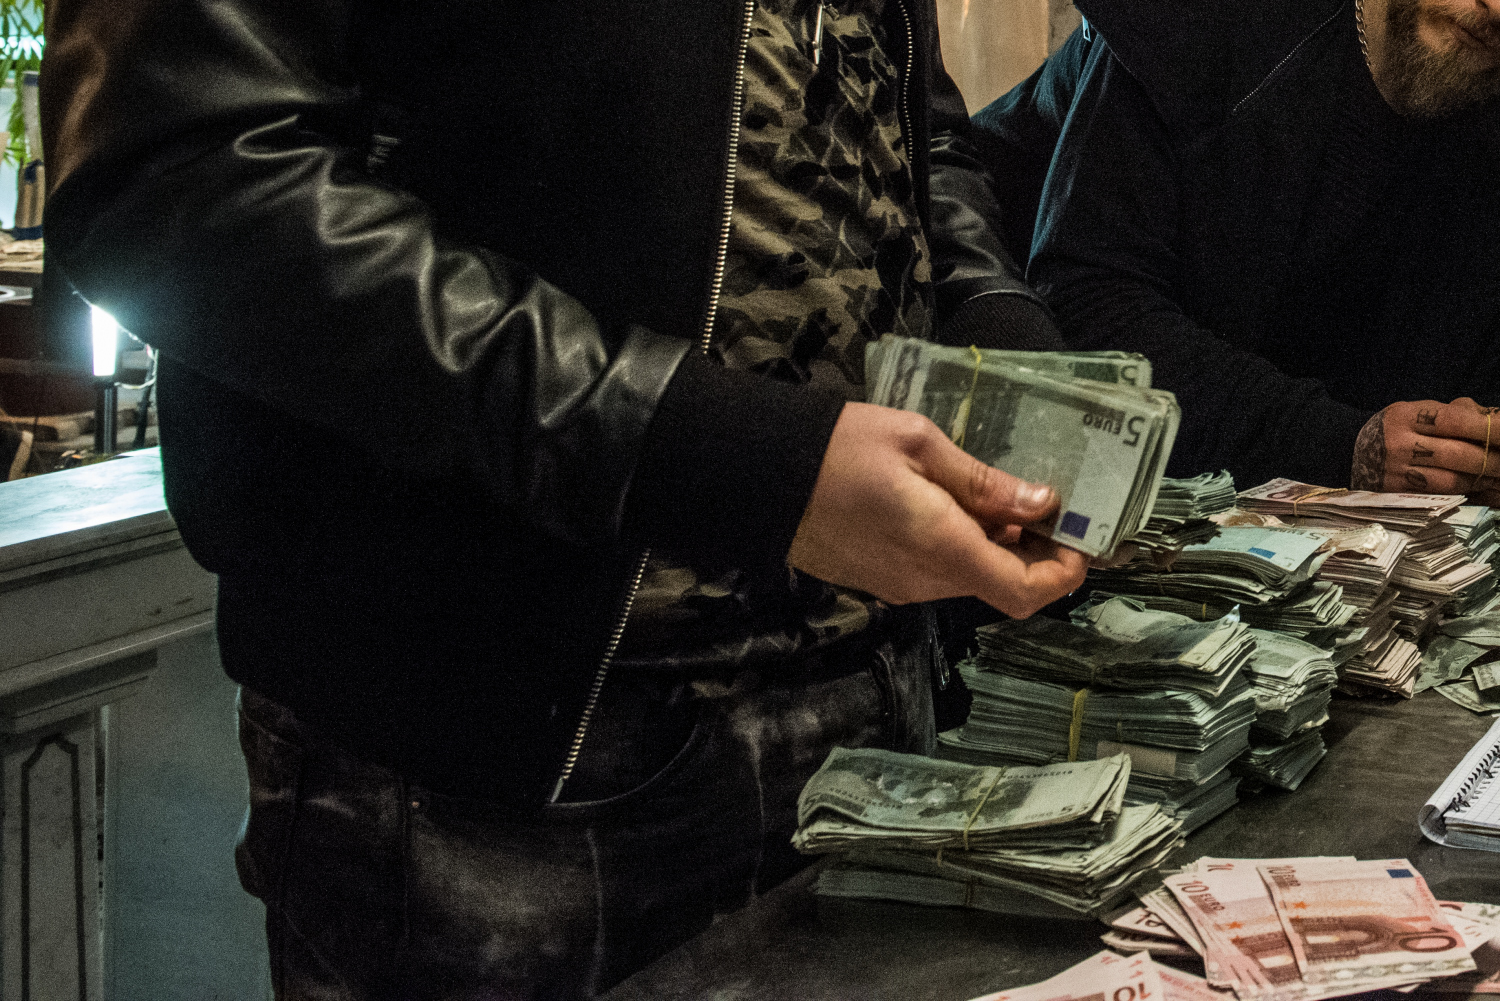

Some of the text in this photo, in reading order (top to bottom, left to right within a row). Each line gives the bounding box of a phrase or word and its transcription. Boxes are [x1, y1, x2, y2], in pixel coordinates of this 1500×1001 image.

[1083, 412, 1146, 447] 5 EURO
[1176, 880, 1225, 911] 10 EURO
[1392, 926, 1457, 953] 10
[1113, 982, 1152, 1001] 10
